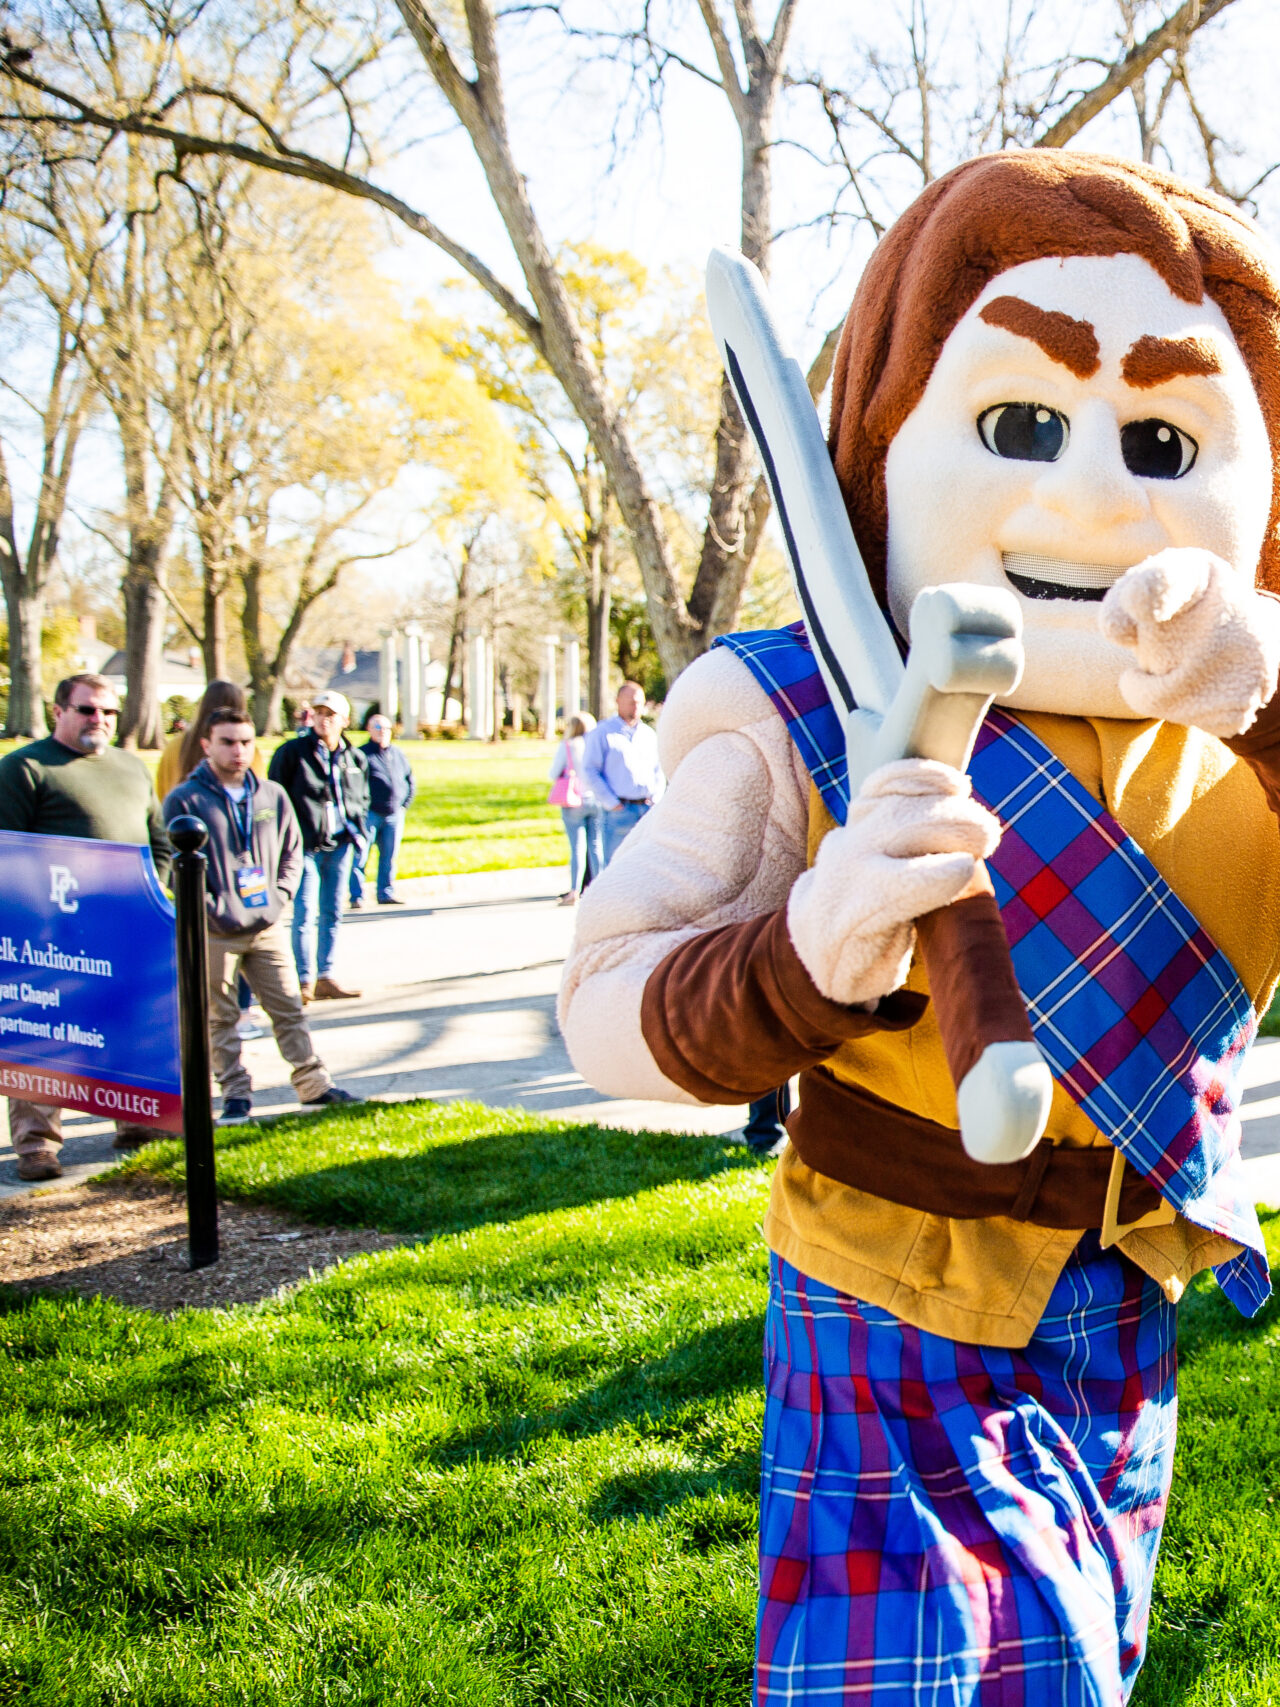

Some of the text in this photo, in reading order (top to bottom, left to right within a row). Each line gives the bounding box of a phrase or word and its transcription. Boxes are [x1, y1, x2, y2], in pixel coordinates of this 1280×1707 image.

[48, 863, 79, 914] PC
[20, 939, 113, 977] Auditorium
[20, 982, 60, 1010] Chapel
[53, 1022, 65, 1041] of
[67, 1023, 105, 1049] Music
[94, 1087, 160, 1117] COLLEGE
